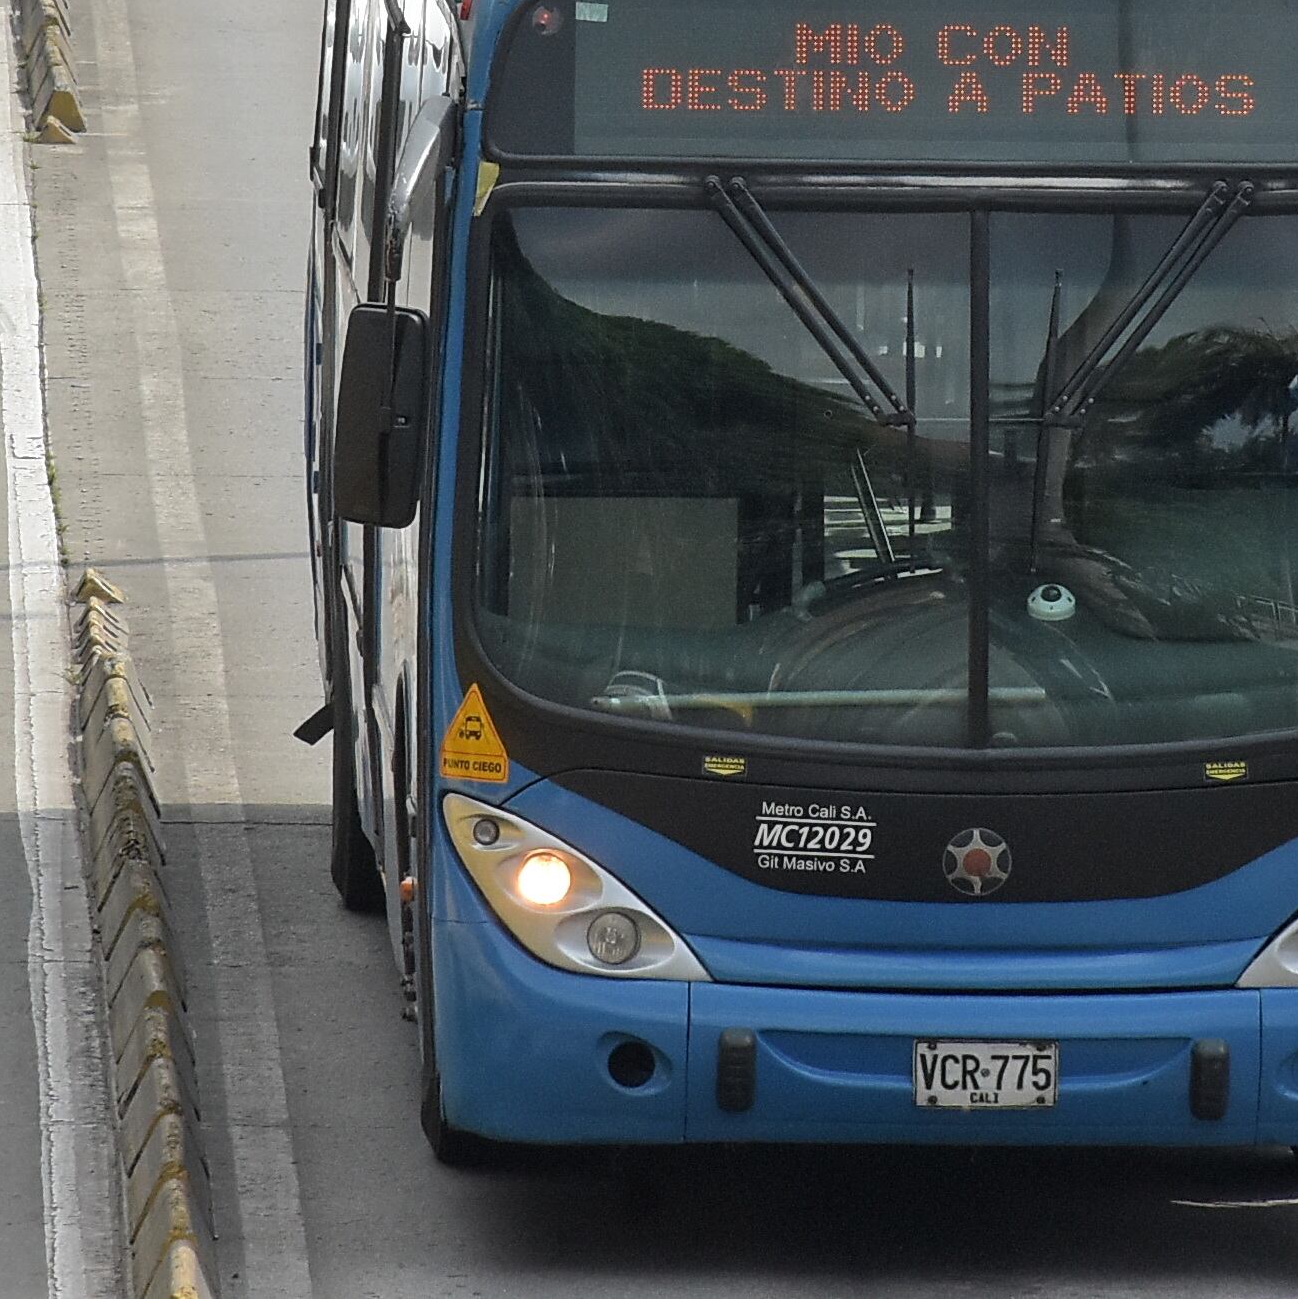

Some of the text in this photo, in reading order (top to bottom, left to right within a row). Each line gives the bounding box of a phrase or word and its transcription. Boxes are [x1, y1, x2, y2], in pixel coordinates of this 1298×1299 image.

[795, 23, 1069, 67] MIO CON
[640, 68, 1255, 115] DESTINO A PATIOS
[443, 757, 502, 773] PUNTO CIEGO
[704, 756, 745, 764] SALIDAS
[1205, 761, 1245, 769] SALIDAS
[762, 801, 872, 820] Metro Cali S.A.
[754, 823, 872, 852] MC12029
[758, 855, 866, 874] Git Masivo S.A
[969, 1092, 999, 1104] CALI
